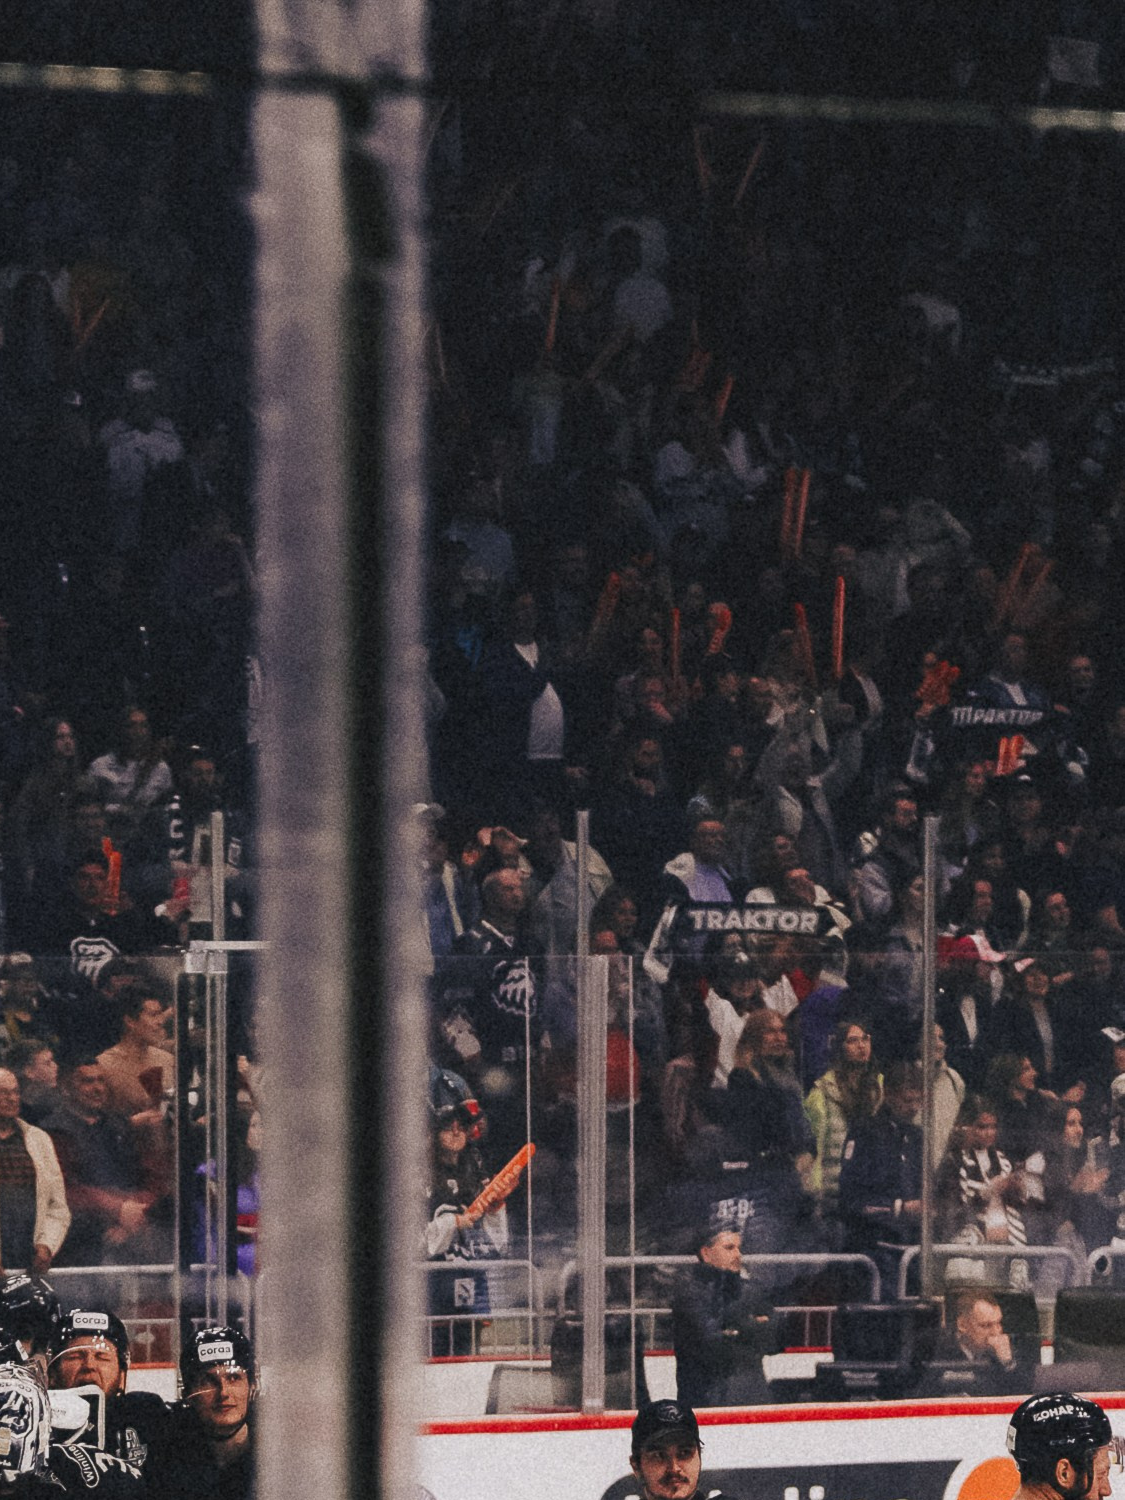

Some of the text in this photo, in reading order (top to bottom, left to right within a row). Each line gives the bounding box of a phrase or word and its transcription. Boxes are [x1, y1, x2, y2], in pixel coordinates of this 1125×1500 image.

[689, 908, 819, 935] TRAKTOR
[75, 1315, 107, 1326] согаз
[199, 1345, 231, 1357] согаз
[1033, 1404, 1075, 1422] КОНАР
